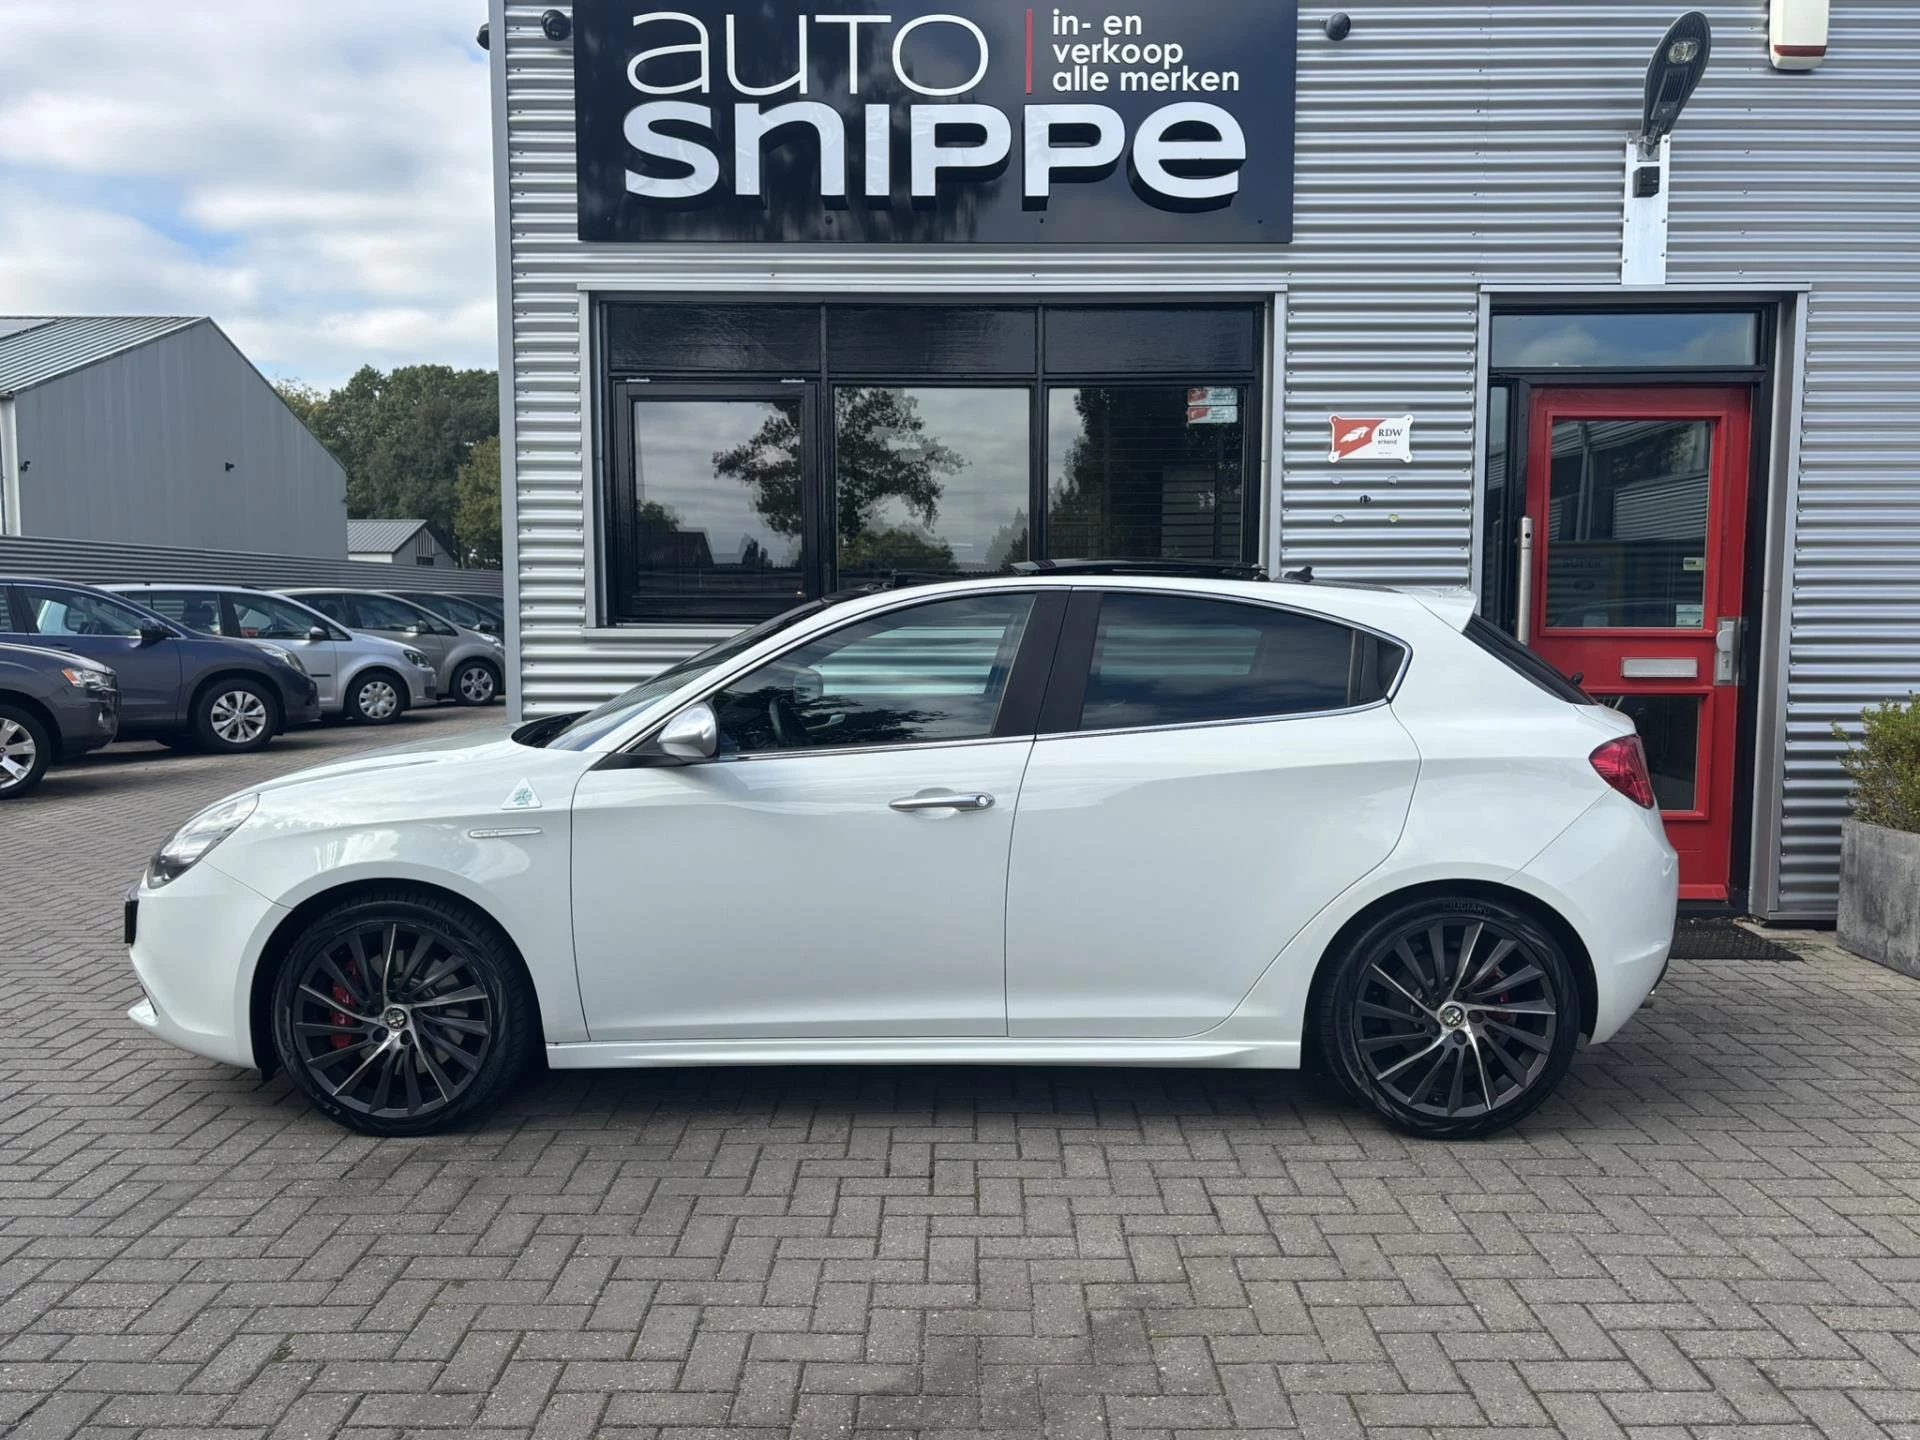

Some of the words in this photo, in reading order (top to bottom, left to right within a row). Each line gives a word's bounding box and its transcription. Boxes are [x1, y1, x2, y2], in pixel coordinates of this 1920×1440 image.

[1053, 8, 1092, 35] in-
[1103, 15, 1142, 35] en
[1053, 37, 1184, 70] verkoop
[1053, 65, 1109, 92] alle
[1120, 65, 1240, 92] merken
[1378, 428, 1403, 437] RDW
